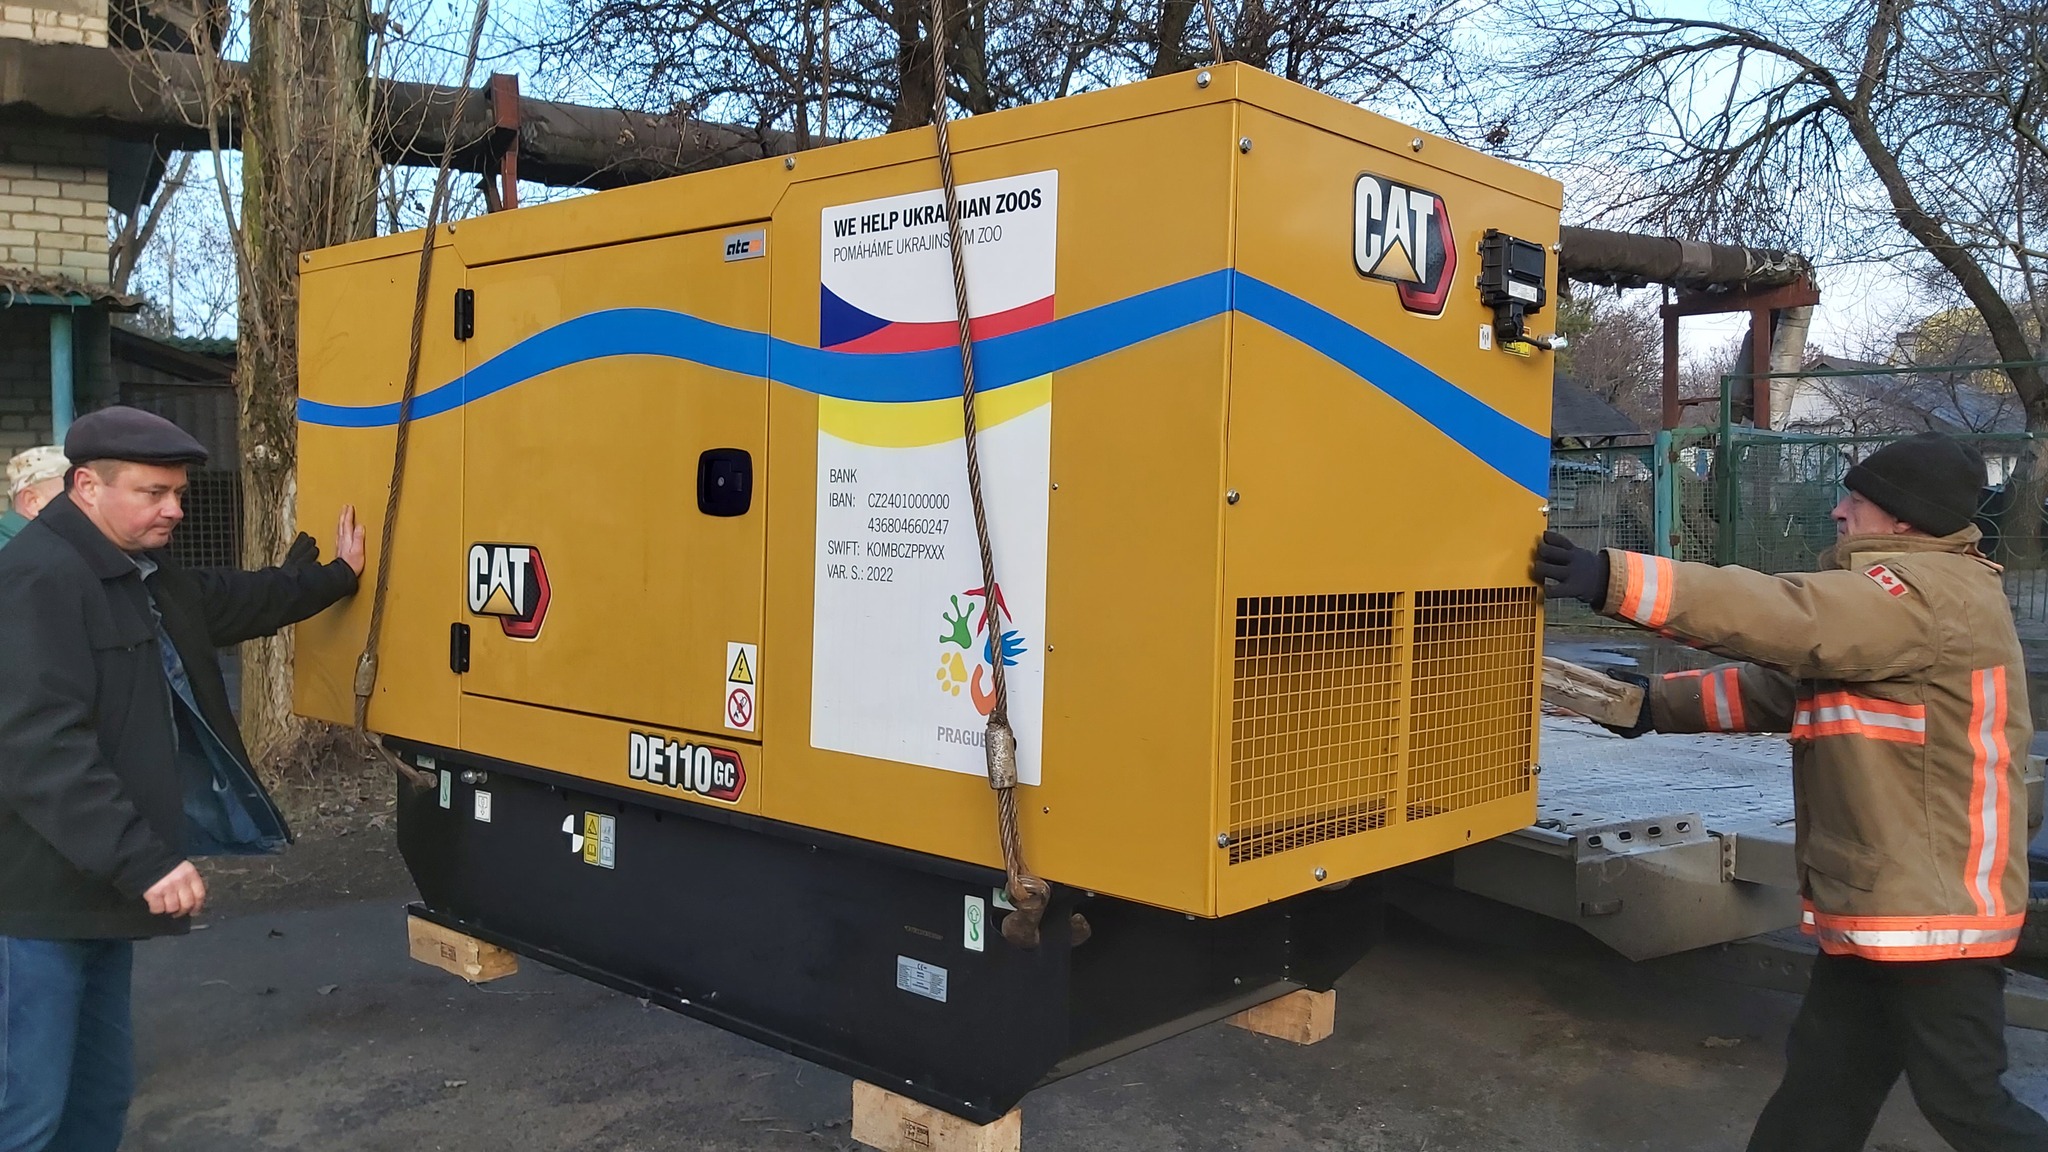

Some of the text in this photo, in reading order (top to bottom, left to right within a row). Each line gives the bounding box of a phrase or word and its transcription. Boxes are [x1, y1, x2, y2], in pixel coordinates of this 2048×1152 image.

[834, 217, 857, 238] WE
[861, 211, 899, 234] HELP
[995, 188, 1042, 214] ZOOS
[1355, 176, 1434, 284] CAT
[726, 239, 750, 255] atc
[833, 239, 894, 262] POMÁHÁME
[977, 225, 1003, 244] ZOO
[829, 468, 858, 483] BANK
[829, 492, 950, 510] IBAN: CZ2401000000
[867, 517, 949, 535] 436804660247
[827, 540, 945, 560] SWIFT: KOMBCZPPXXX
[469, 545, 530, 616] CAT
[827, 564, 848, 580] VAR.
[866, 565, 894, 582] 2022
[937, 726, 986, 748] PRAGUE
[630, 732, 735, 794] DE110 GC
